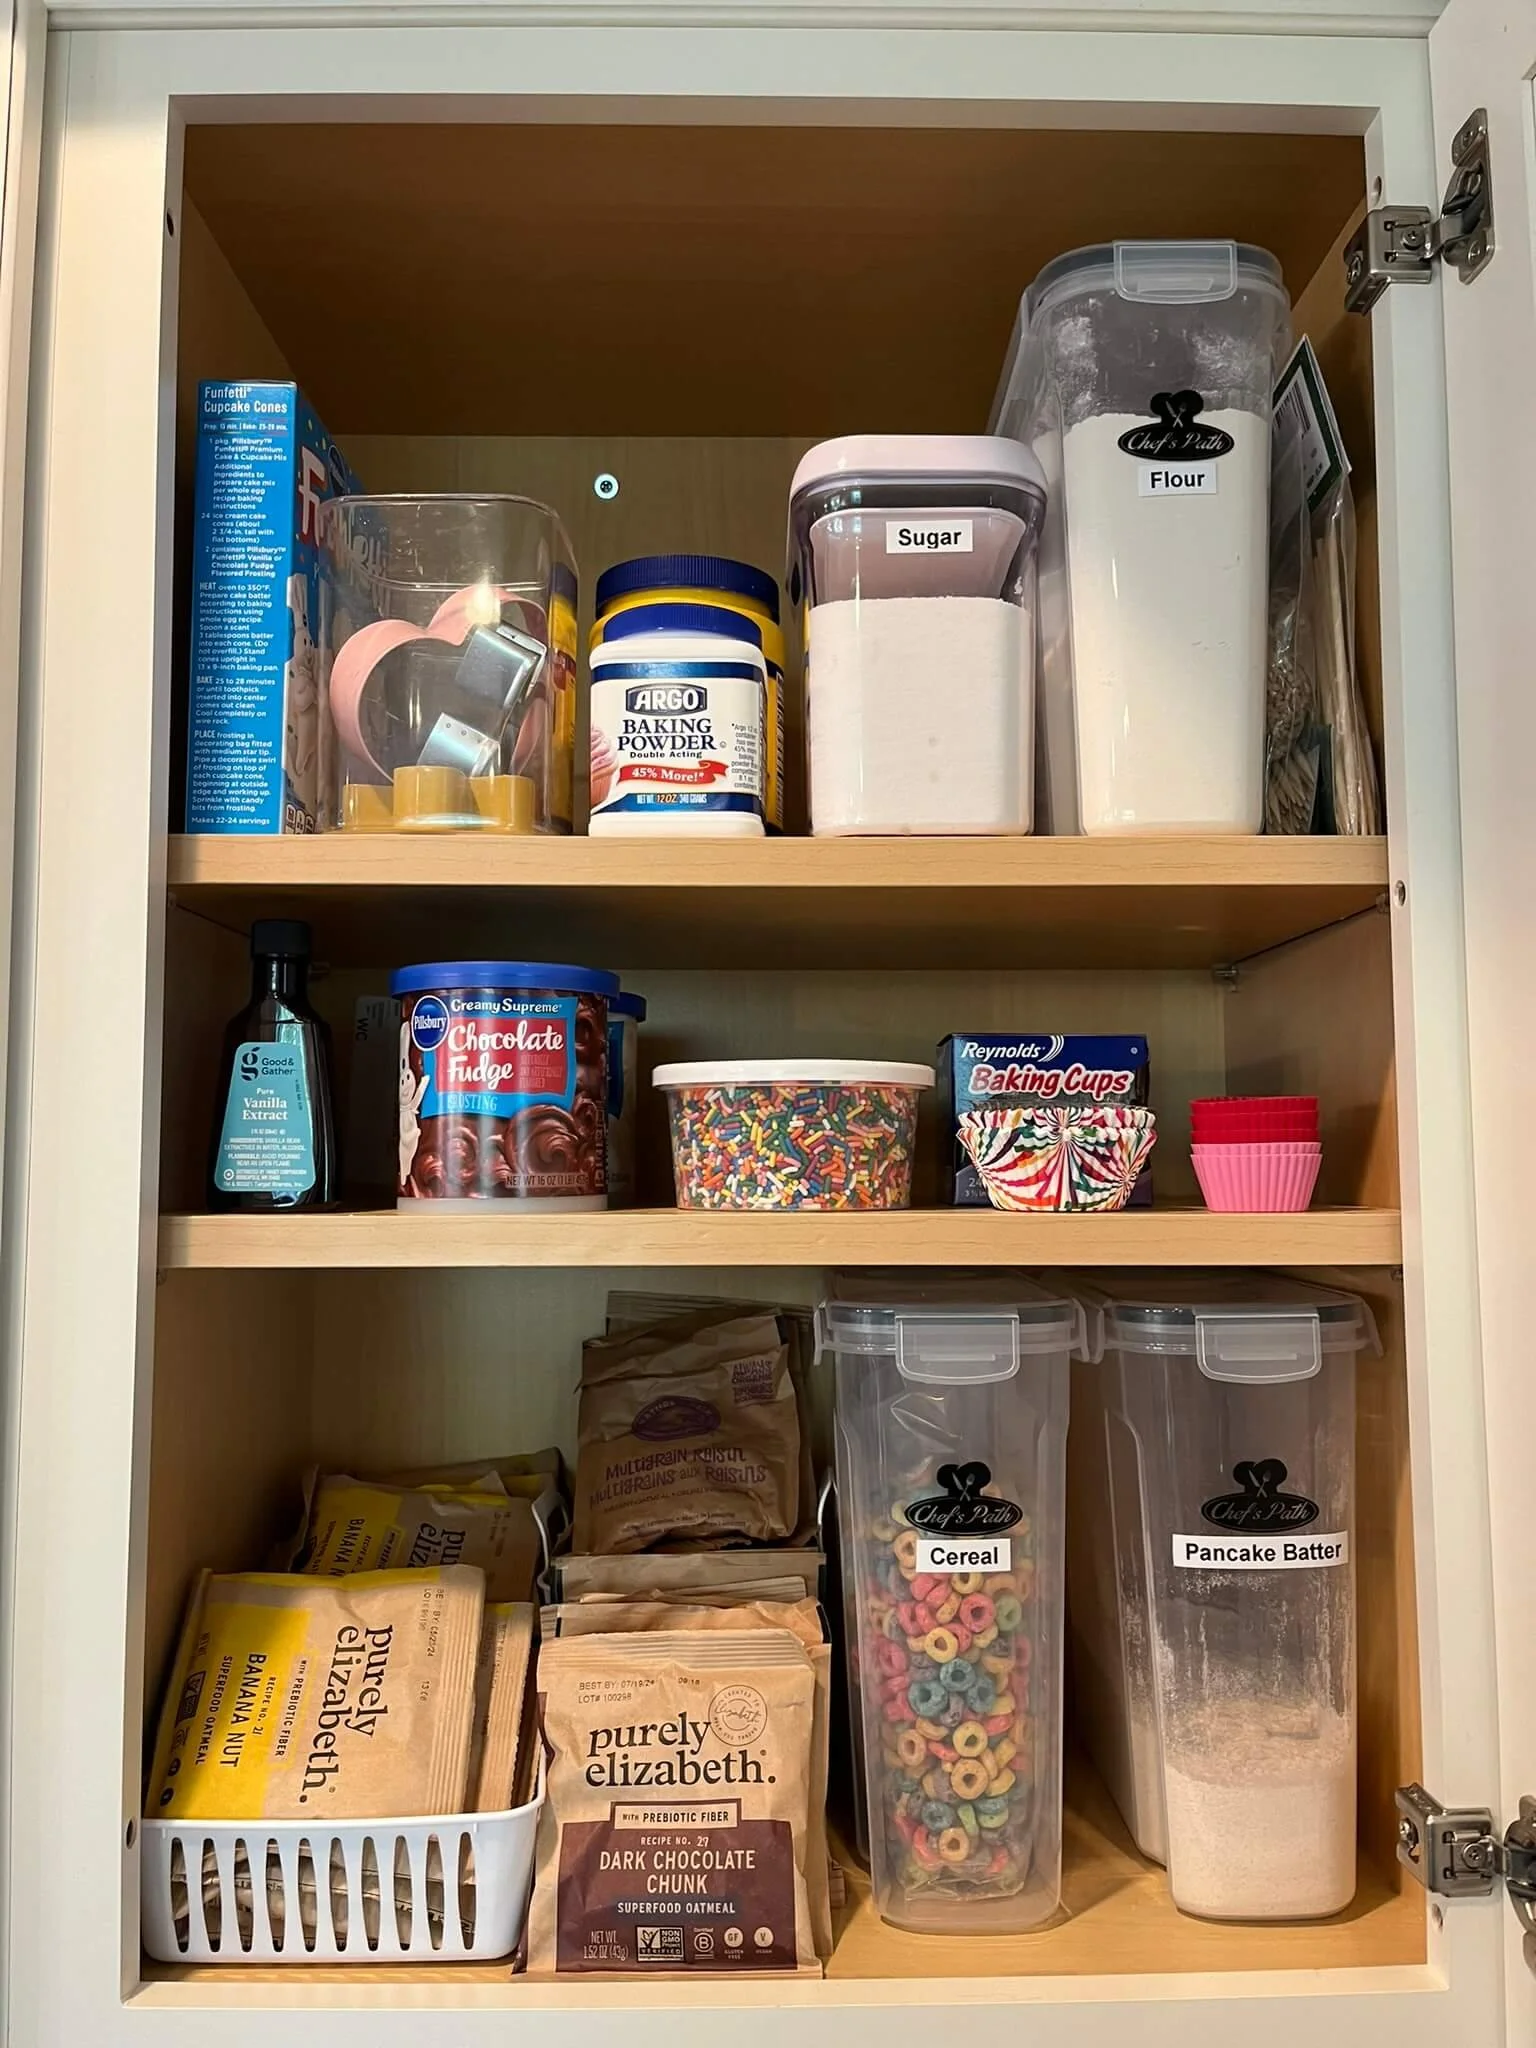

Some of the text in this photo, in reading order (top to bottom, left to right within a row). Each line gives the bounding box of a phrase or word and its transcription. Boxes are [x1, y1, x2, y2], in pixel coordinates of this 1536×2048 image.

[204, 400, 288, 415] Cupcake Cones
[1128, 429, 1226, 451] Chef's Path
[1151, 471, 1205, 489] Flour
[898, 528, 962, 549] Sugar
[200, 582, 216, 590] HEAT
[196, 676, 213, 684] BAKE
[634, 689, 699, 710] ARGO
[194, 730, 215, 738] PLACE
[622, 718, 712, 734] BAKING
[617, 735, 717, 751] POWDER
[630, 751, 702, 759] Double Acting
[632, 768, 657, 778] 45%
[239, 817, 270, 825] servings
[451, 998, 560, 1014] Creamy Supreme
[414, 1015, 447, 1032] Pillsbury
[449, 1020, 564, 1053] Chocolate
[961, 1042, 1041, 1063] Reynolds
[262, 1067, 293, 1075] Gather
[447, 1055, 514, 1090] Fudge
[972, 1066, 1131, 1098] Baking Cups
[244, 1097, 287, 1108] Vanilla
[243, 1110, 288, 1120] Extract
[525, 1176, 534, 1185] WT
[537, 1176, 545, 1185] 16
[547, 1176, 556, 1185] OZ
[914, 1502, 1013, 1526] Chef's Path
[1210, 1500, 1313, 1524] Chef's Path
[334, 1519, 364, 1562] BANANA
[930, 1546, 999, 1567] Cereal
[1185, 1540, 1342, 1563] Pancake Batter
[347, 1624, 393, 1738] purely
[580, 1682, 602, 1690] BEST
[263, 1677, 276, 1704] RECIPE
[196, 1656, 232, 1765] SUPERFOOD OATMEAL
[220, 1654, 267, 1767] BANANA NUT
[284, 1678, 303, 1726] PREBIOTIC
[258, 1708, 268, 1721] NO.
[299, 1625, 360, 1804] elizabeth.
[275, 1730, 290, 1756] FIBER
[586, 1711, 713, 1758] purely
[585, 1749, 776, 1788] elizabeth.
[622, 1811, 729, 1823] WITH PREBIOTIC FIBER
[641, 1836, 671, 1845] RECIPE
[676, 1836, 691, 1845] NO.
[599, 1849, 756, 1871] DARK CHOCOLATE
[647, 1874, 708, 1894] CHUNK
[617, 1902, 736, 1914] SUPERFOOD OATMEAL
[591, 1930, 604, 1944] NET
[727, 1933, 739, 1941] GF
[760, 1933, 766, 1942] V
[599, 1945, 608, 1958] OZ
